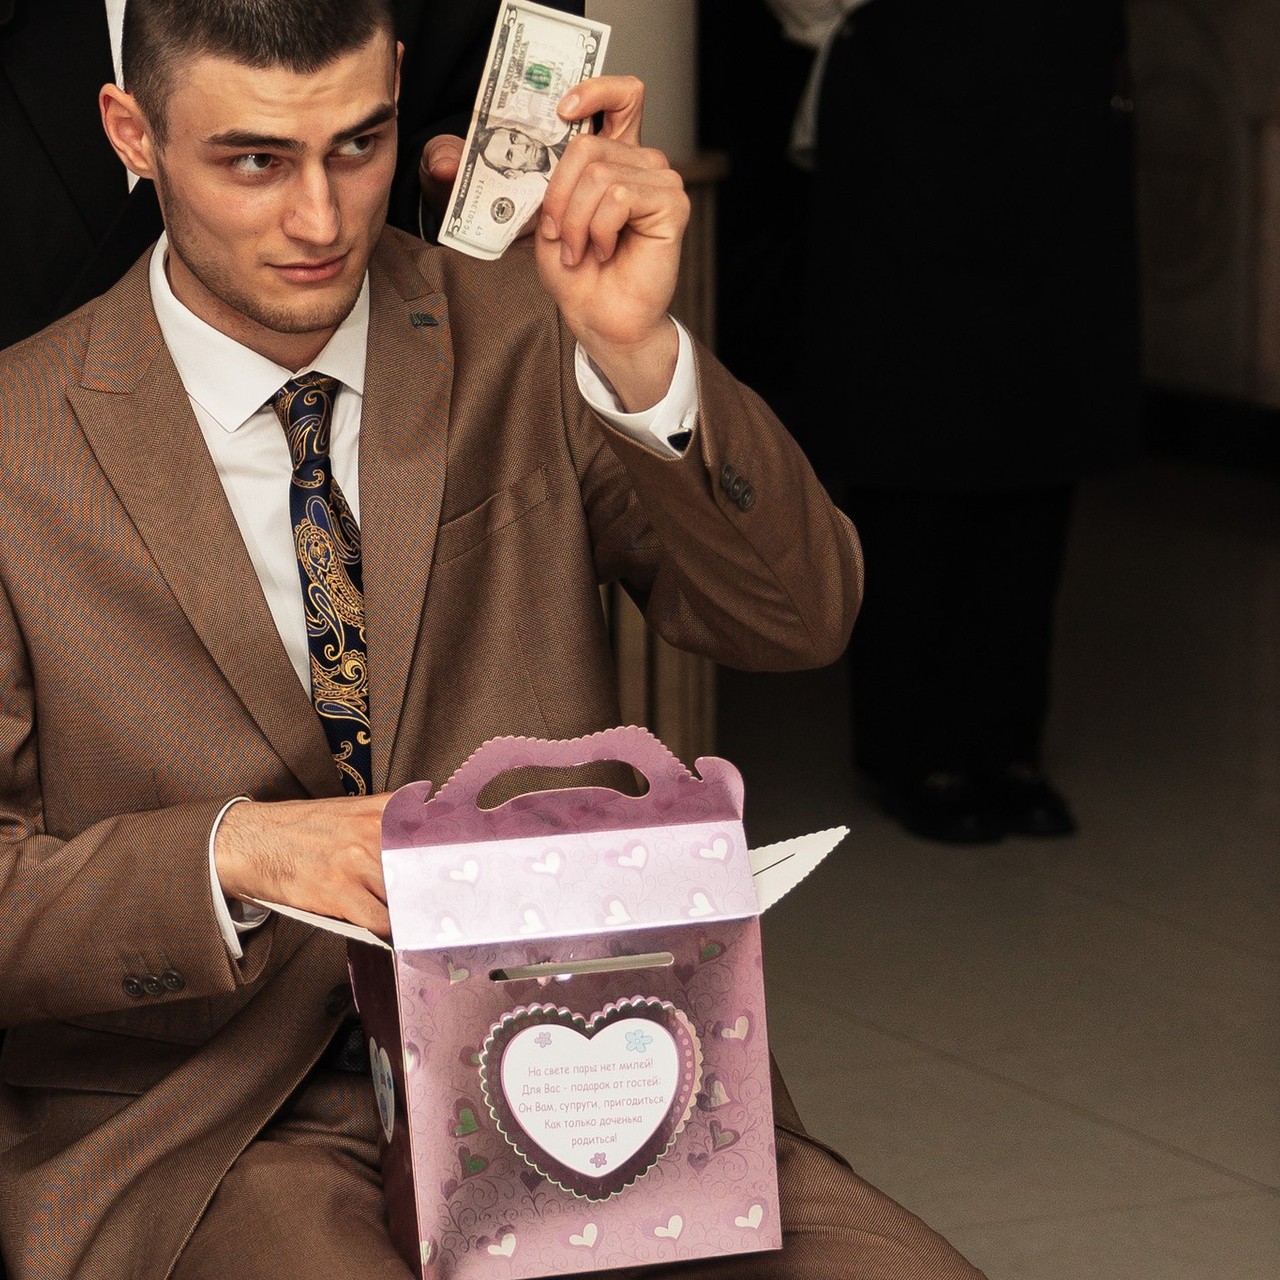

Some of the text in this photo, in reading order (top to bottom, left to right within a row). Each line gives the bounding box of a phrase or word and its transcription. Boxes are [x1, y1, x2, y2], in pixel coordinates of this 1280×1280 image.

[502, 7, 518, 28] 5
[574, 32, 598, 54] 5
[497, 21, 525, 110] THE UNITED STATES
[510, 39, 529, 94] OF AMERICA
[446, 215, 463, 236] 5
[528, 1058, 653, 1077] На свете пары нет милей!
[522, 1085, 541, 1096] Для
[544, 1083, 560, 1094] Вас
[571, 1082, 610, 1095] подарок
[613, 1081, 623, 1089] от
[626, 1076, 661, 1088] гостей:
[518, 1095, 666, 1113] Он Вам, супруги, пригодиться,
[545, 1115, 643, 1129] Как только доченька
[572, 1133, 617, 1149] родиться!
